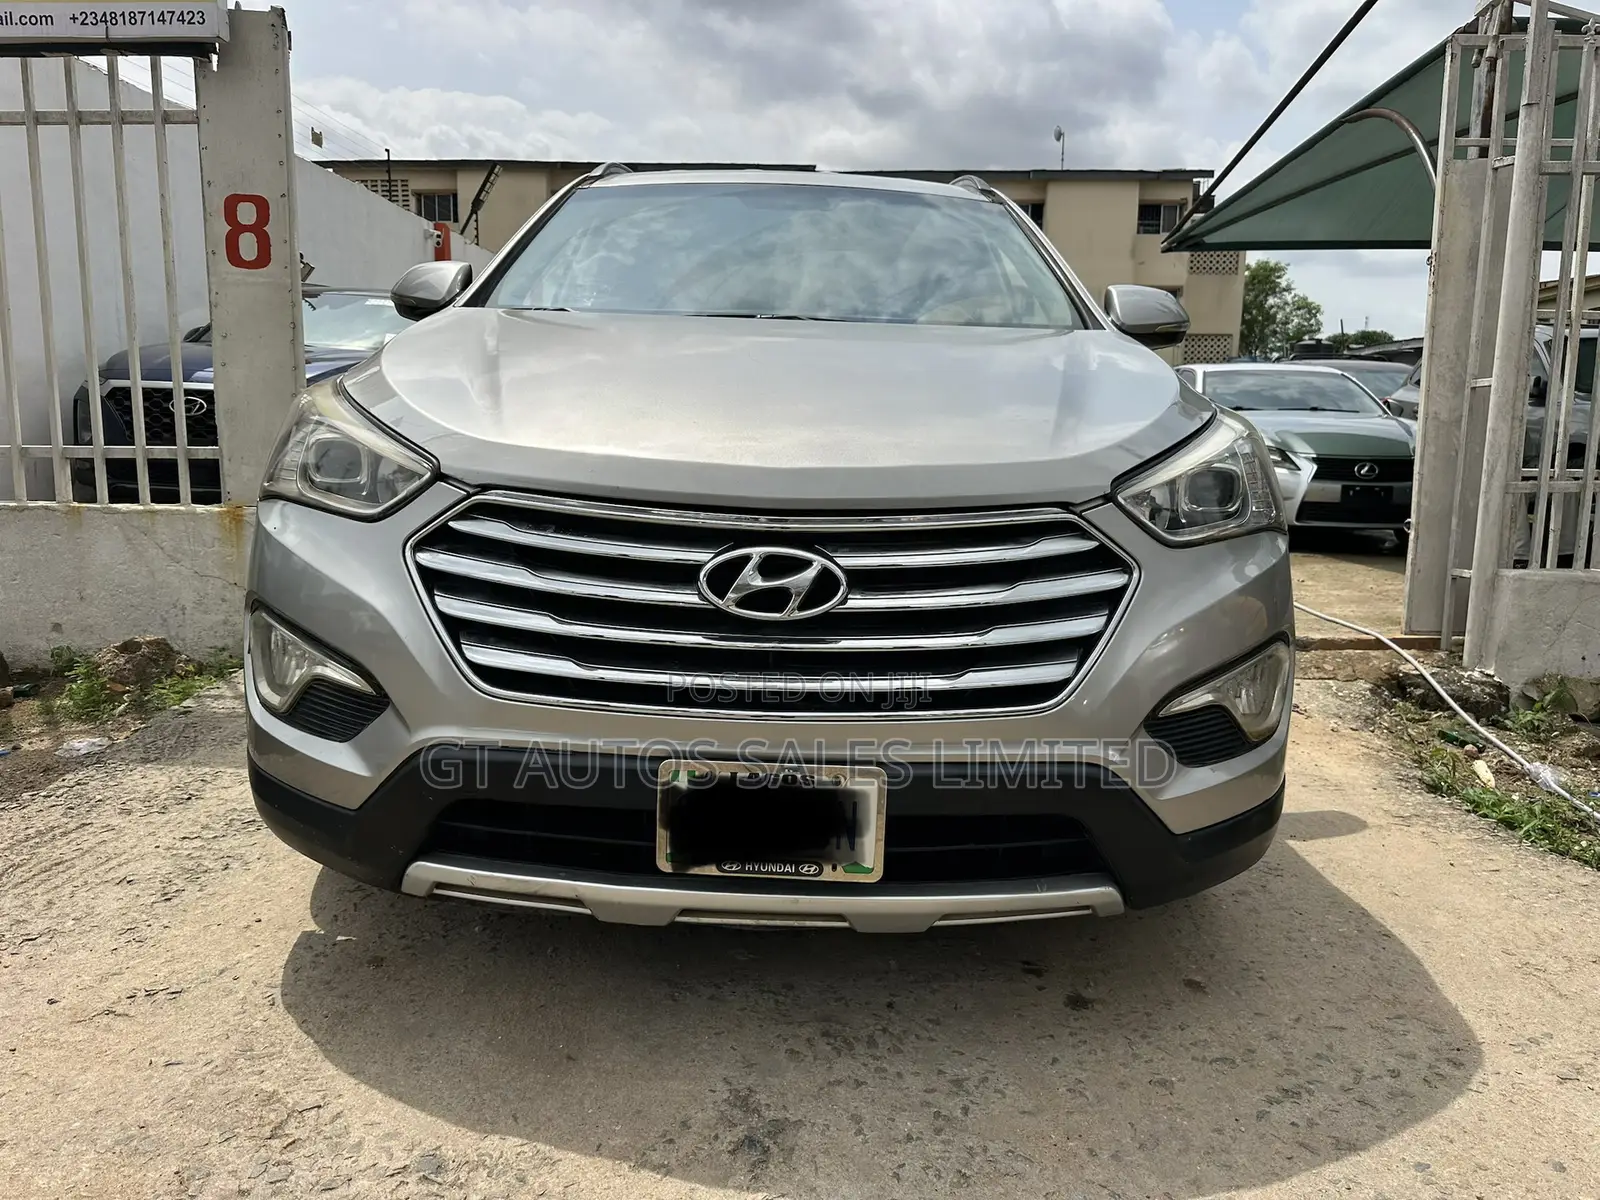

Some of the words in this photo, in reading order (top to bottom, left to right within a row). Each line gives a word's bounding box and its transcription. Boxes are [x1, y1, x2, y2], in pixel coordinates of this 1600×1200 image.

[69, 10, 206, 26] +2348187147423
[223, 193, 272, 270] 8
[745, 862, 796, 874] HYUNDAI
